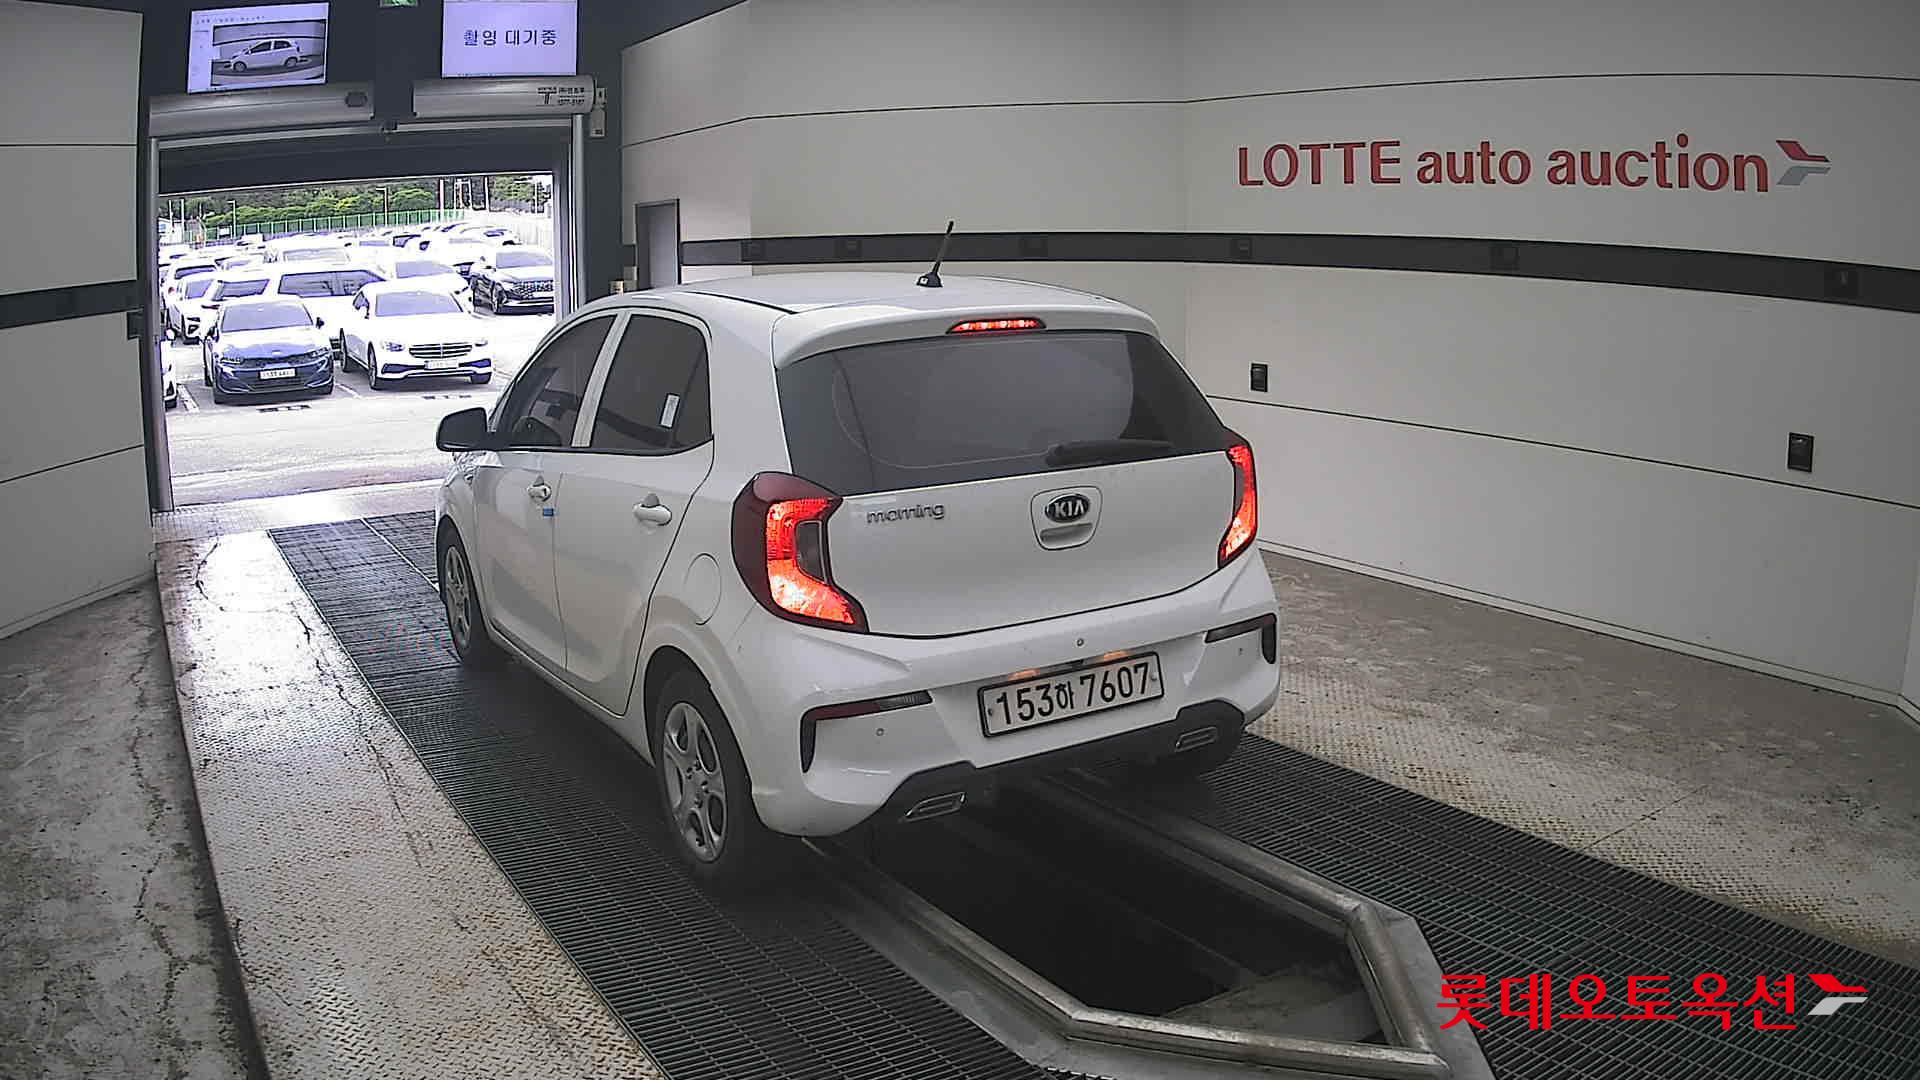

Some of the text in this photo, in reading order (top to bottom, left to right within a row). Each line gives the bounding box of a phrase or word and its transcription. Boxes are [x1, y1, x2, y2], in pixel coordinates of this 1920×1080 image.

[505, 29, 556, 46] 대기중
[1239, 134, 1769, 192] LOTTE auto auction
[867, 504, 944, 524] morning
[1054, 499, 1085, 518] KIA
[1079, 662, 1149, 707] 7607
